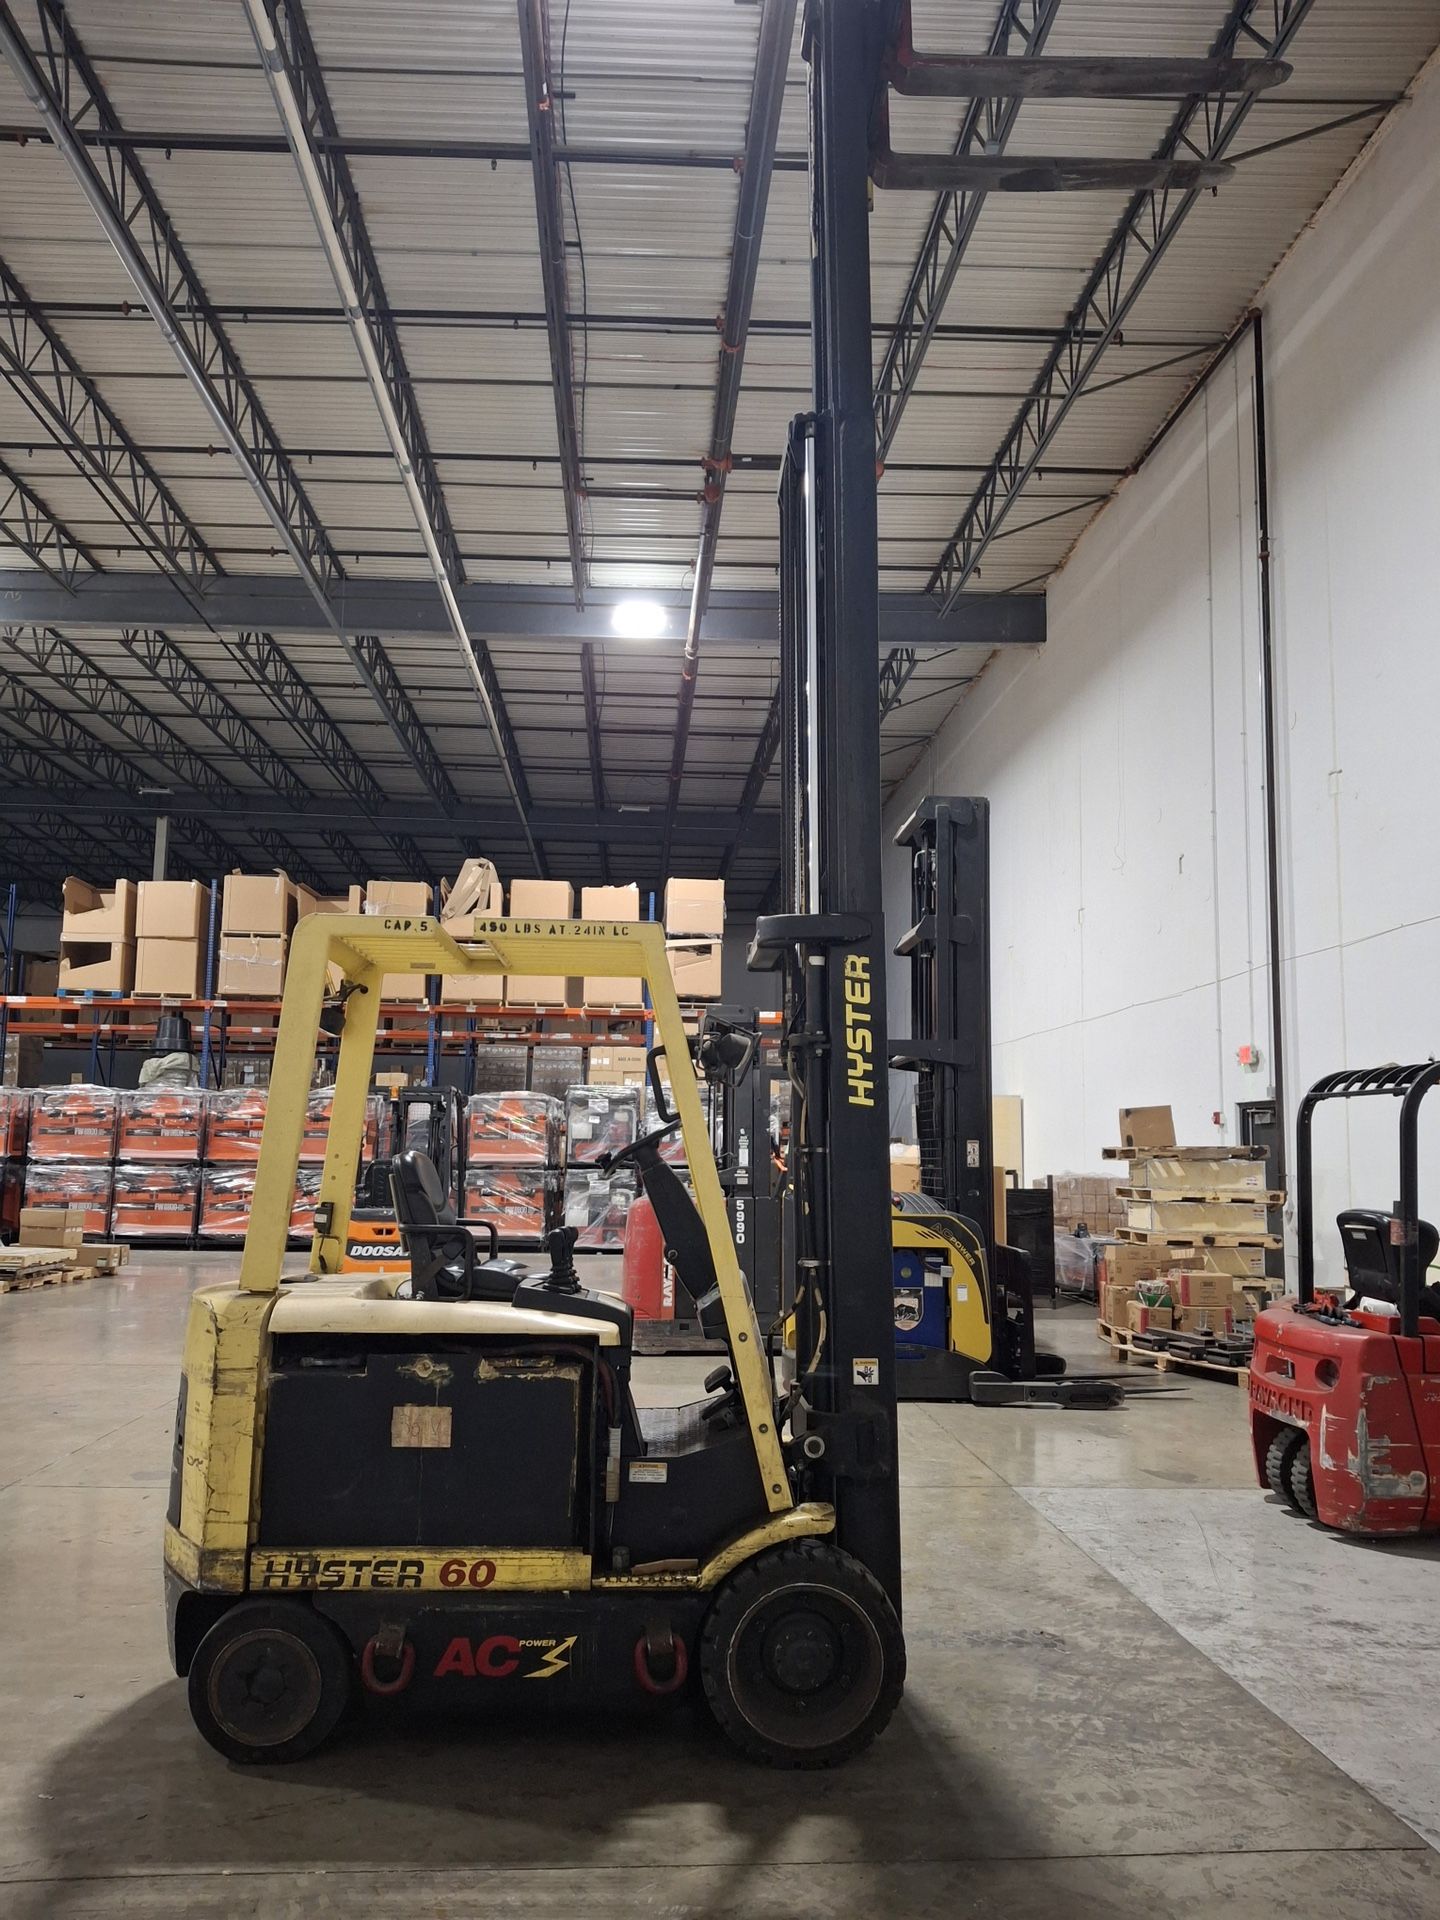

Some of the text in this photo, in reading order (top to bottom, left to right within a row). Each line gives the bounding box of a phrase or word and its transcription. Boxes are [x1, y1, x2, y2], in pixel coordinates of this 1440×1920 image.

[844, 954, 875, 1107] HYSTER
[736, 1199, 746, 1244] 5990
[950, 1236, 976, 1266] POWER
[262, 1559, 497, 1588] HYSTER 60
[433, 1635, 557, 1677] AC POWER
